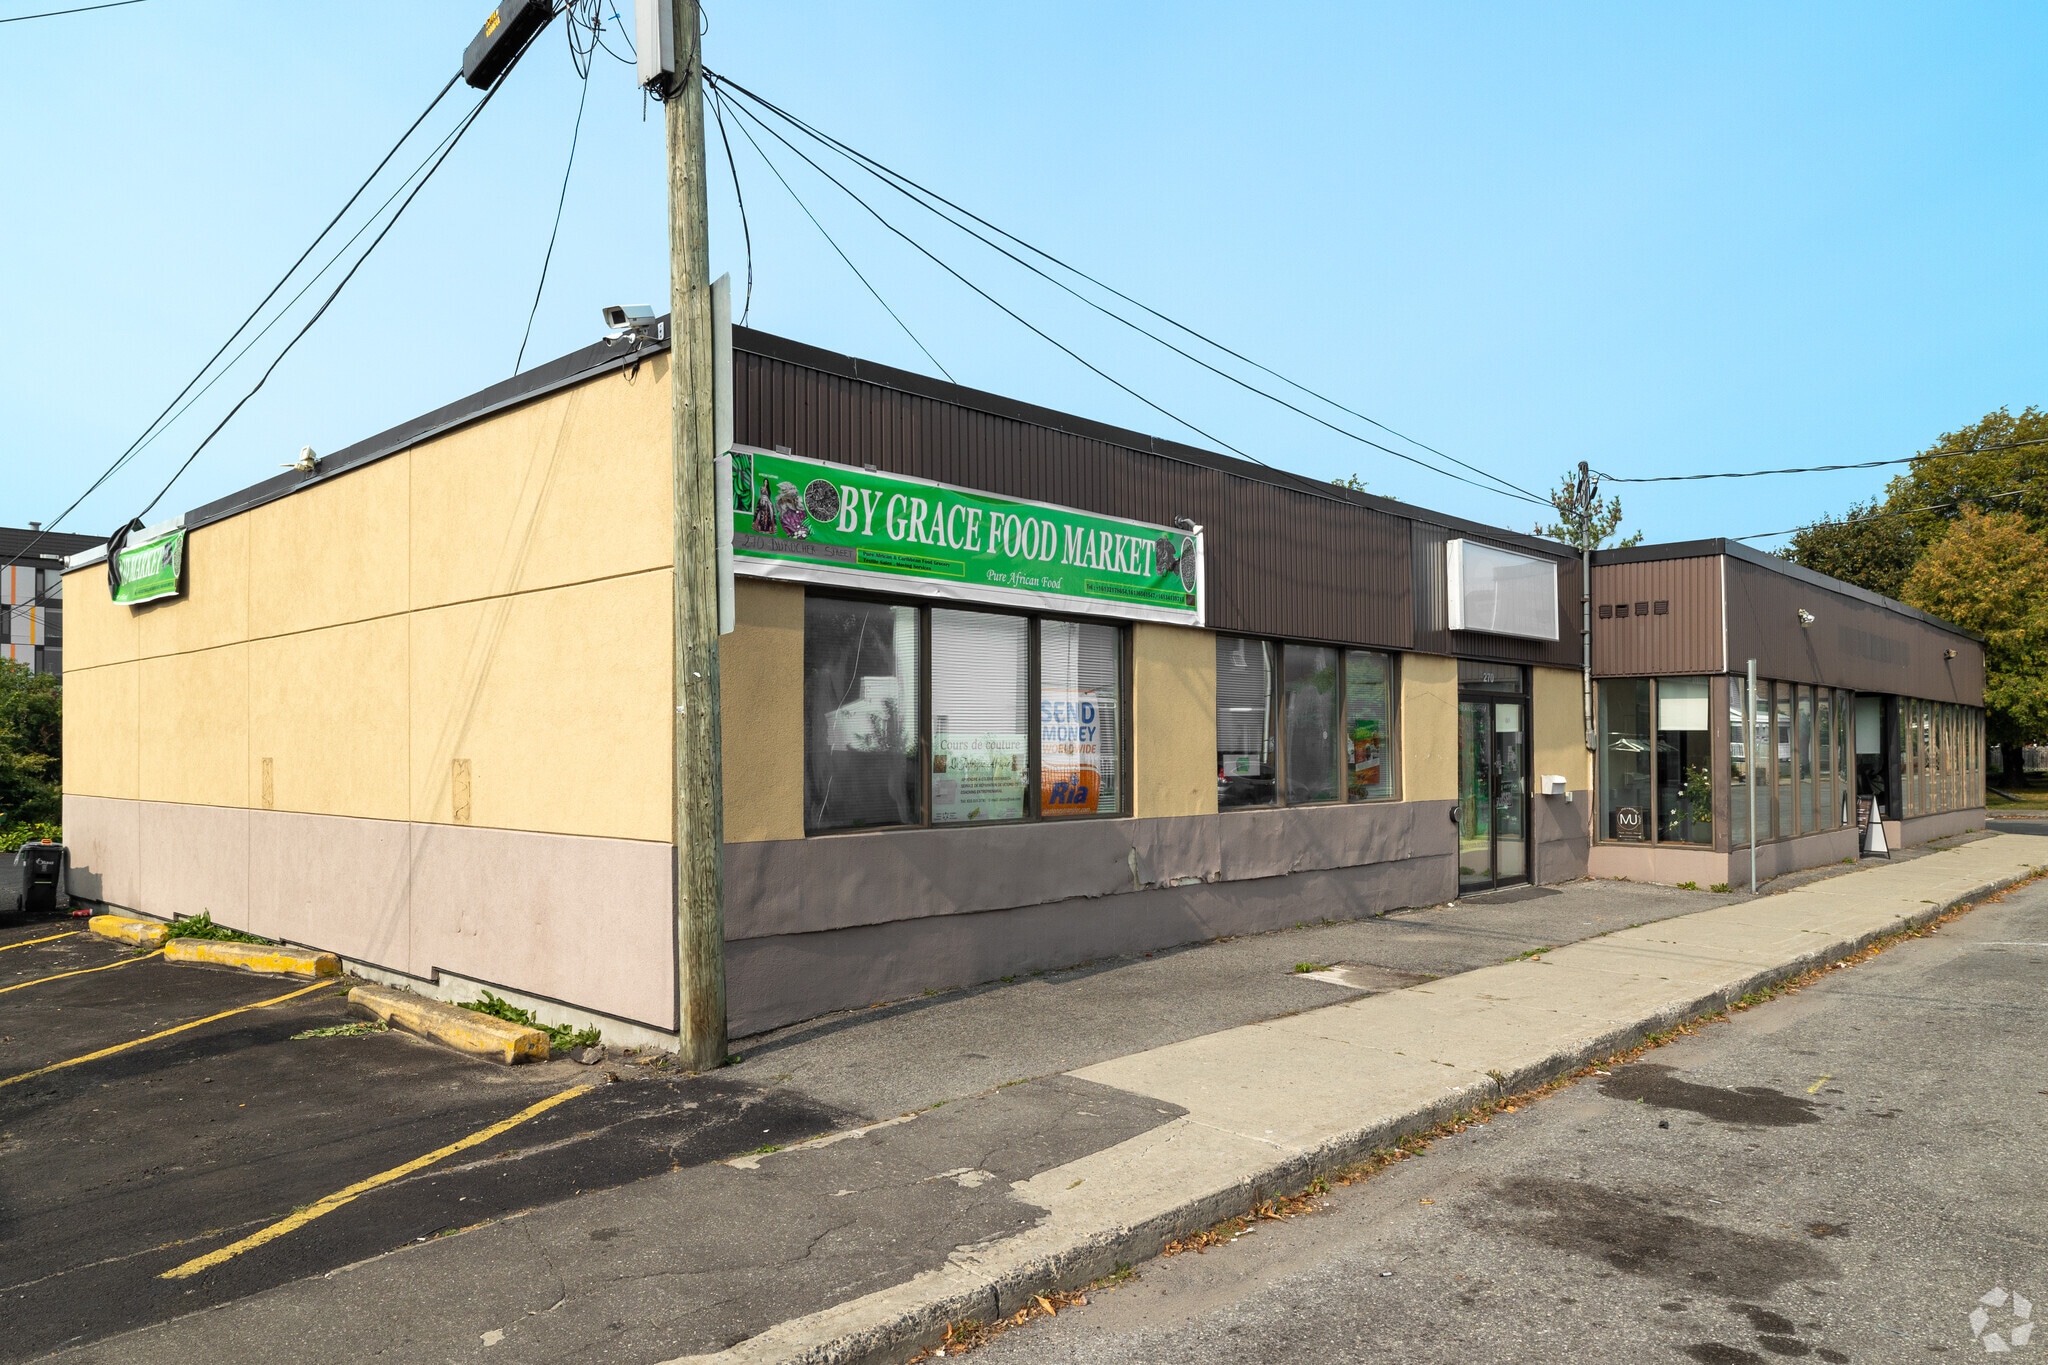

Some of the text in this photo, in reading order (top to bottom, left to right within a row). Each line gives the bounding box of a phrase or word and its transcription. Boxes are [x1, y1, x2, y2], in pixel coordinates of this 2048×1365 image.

[837, 485, 1157, 578] BY GRACE FOOD MARKET
[741, 534, 765, 550] 270
[824, 546, 853, 558] STREET
[128, 545, 164, 583] MARKET
[986, 569, 1063, 589] Pure African Food
[1483, 672, 1495, 683] 270
[1041, 700, 1095, 724] SEND
[1042, 726, 1097, 742] MONEY
[940, 739, 1021, 750] Cours de couture
[1042, 744, 1097, 754] WORLDWIDE
[1049, 779, 1089, 806] Ria
[1619, 813, 1637, 825] MU
